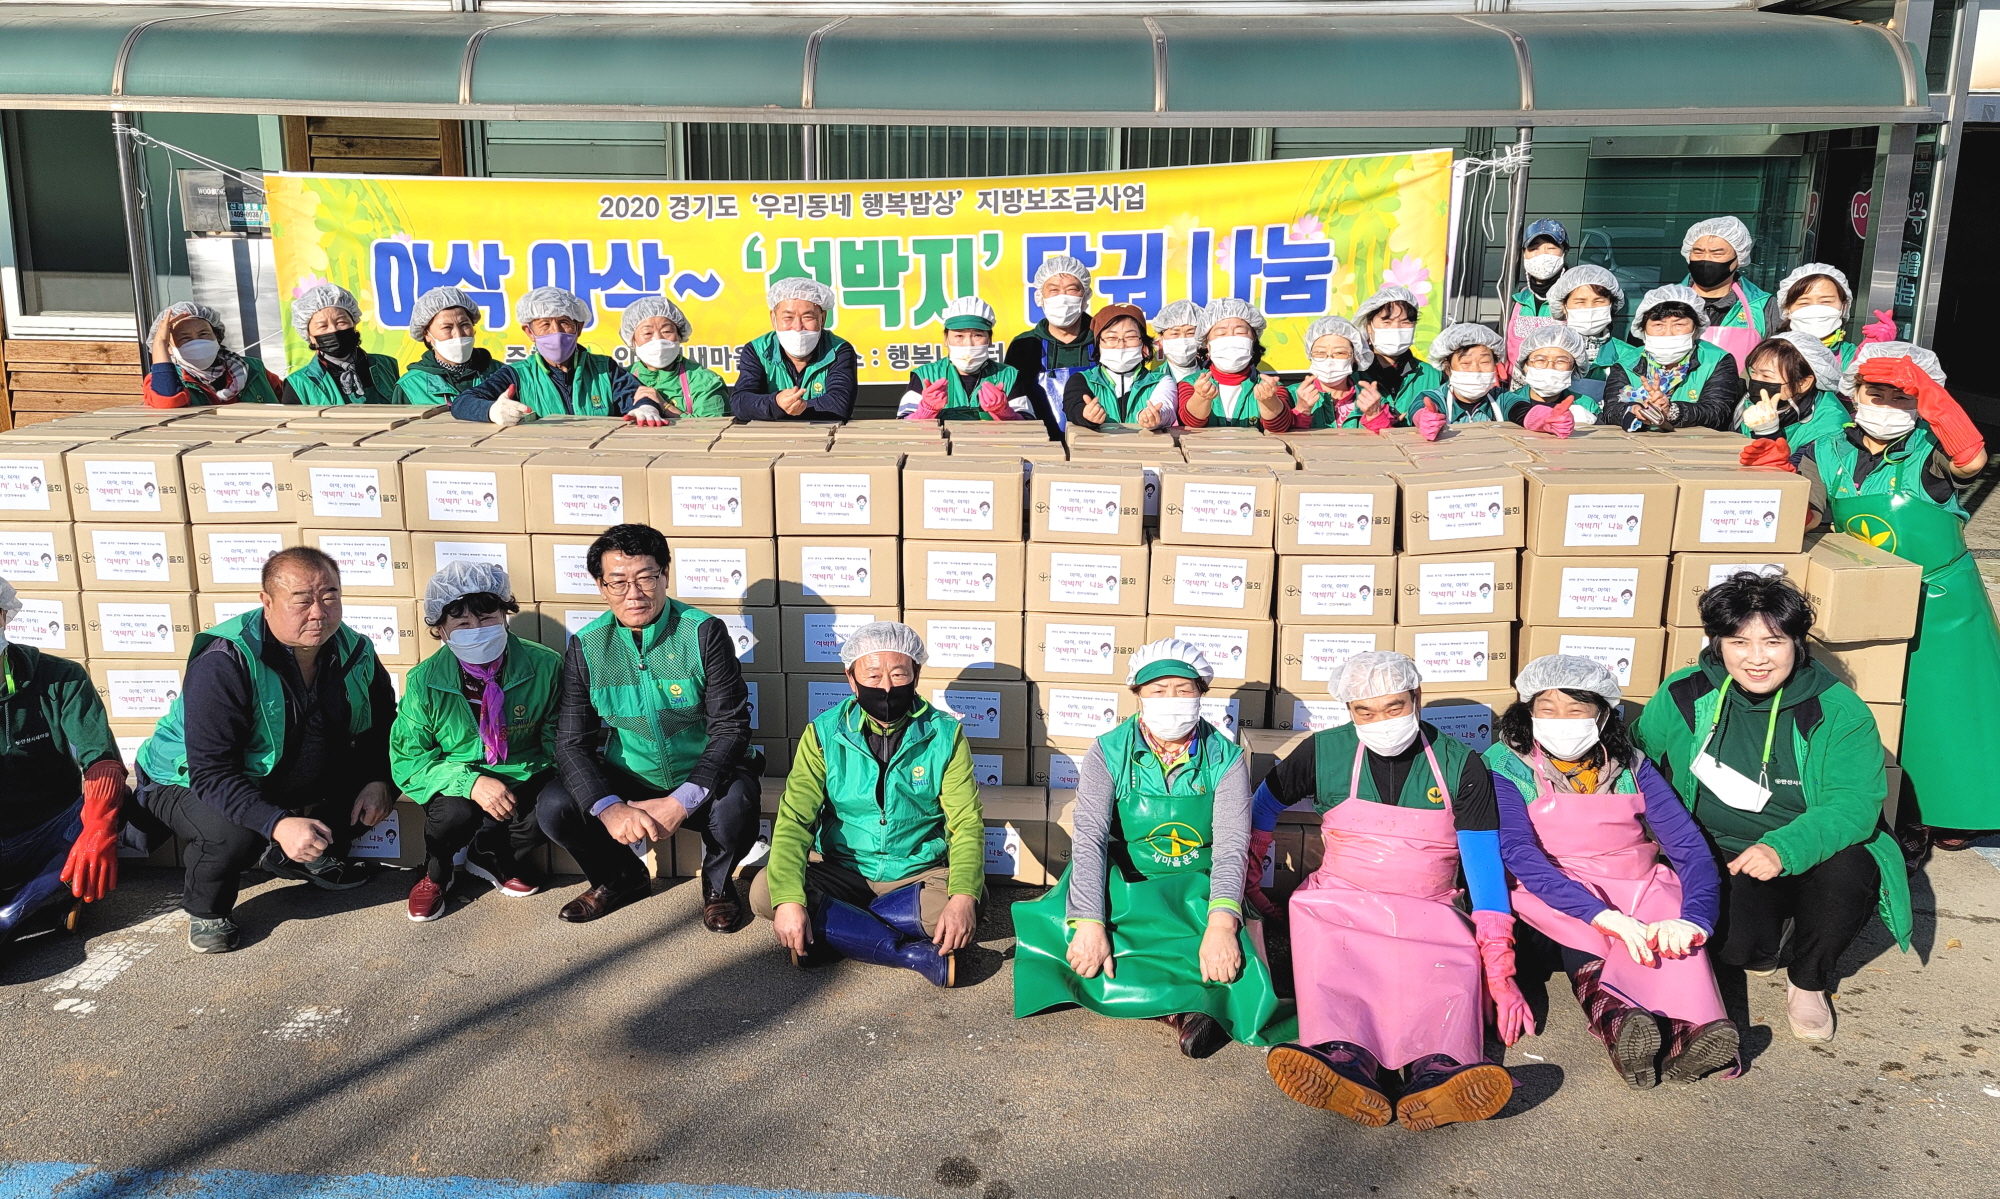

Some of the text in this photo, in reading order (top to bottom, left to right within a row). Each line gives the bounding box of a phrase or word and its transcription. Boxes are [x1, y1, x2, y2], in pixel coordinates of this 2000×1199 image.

[600, 196, 660, 218] 2020
[668, 195, 738, 220] 경기도
[977, 184, 1144, 214] 지방보조금사업
[1191, 226, 1334, 315] 나눔
